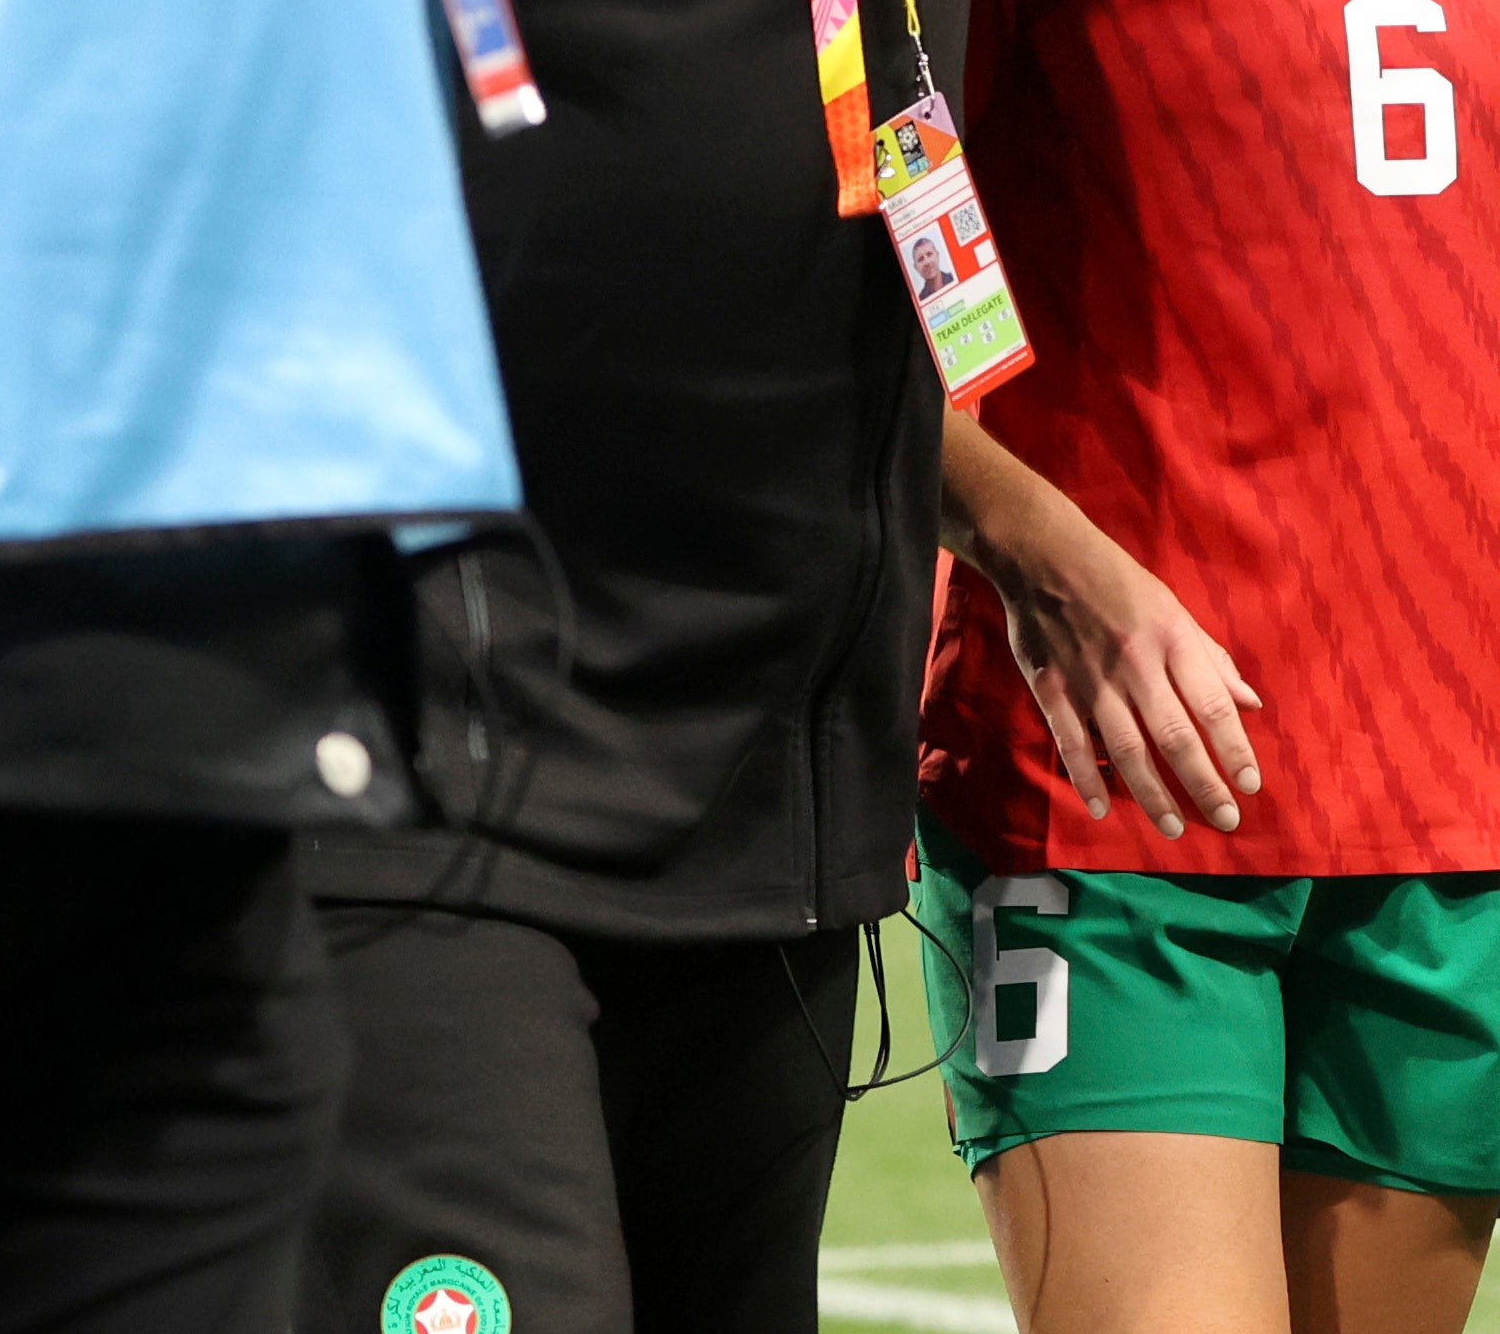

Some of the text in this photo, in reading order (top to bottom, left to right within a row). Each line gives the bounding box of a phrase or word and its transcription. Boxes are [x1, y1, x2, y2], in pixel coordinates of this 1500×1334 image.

[936, 322, 963, 342] TEAM
[960, 294, 1005, 328] DELEGATE
[972, 873, 1070, 1078] 6
